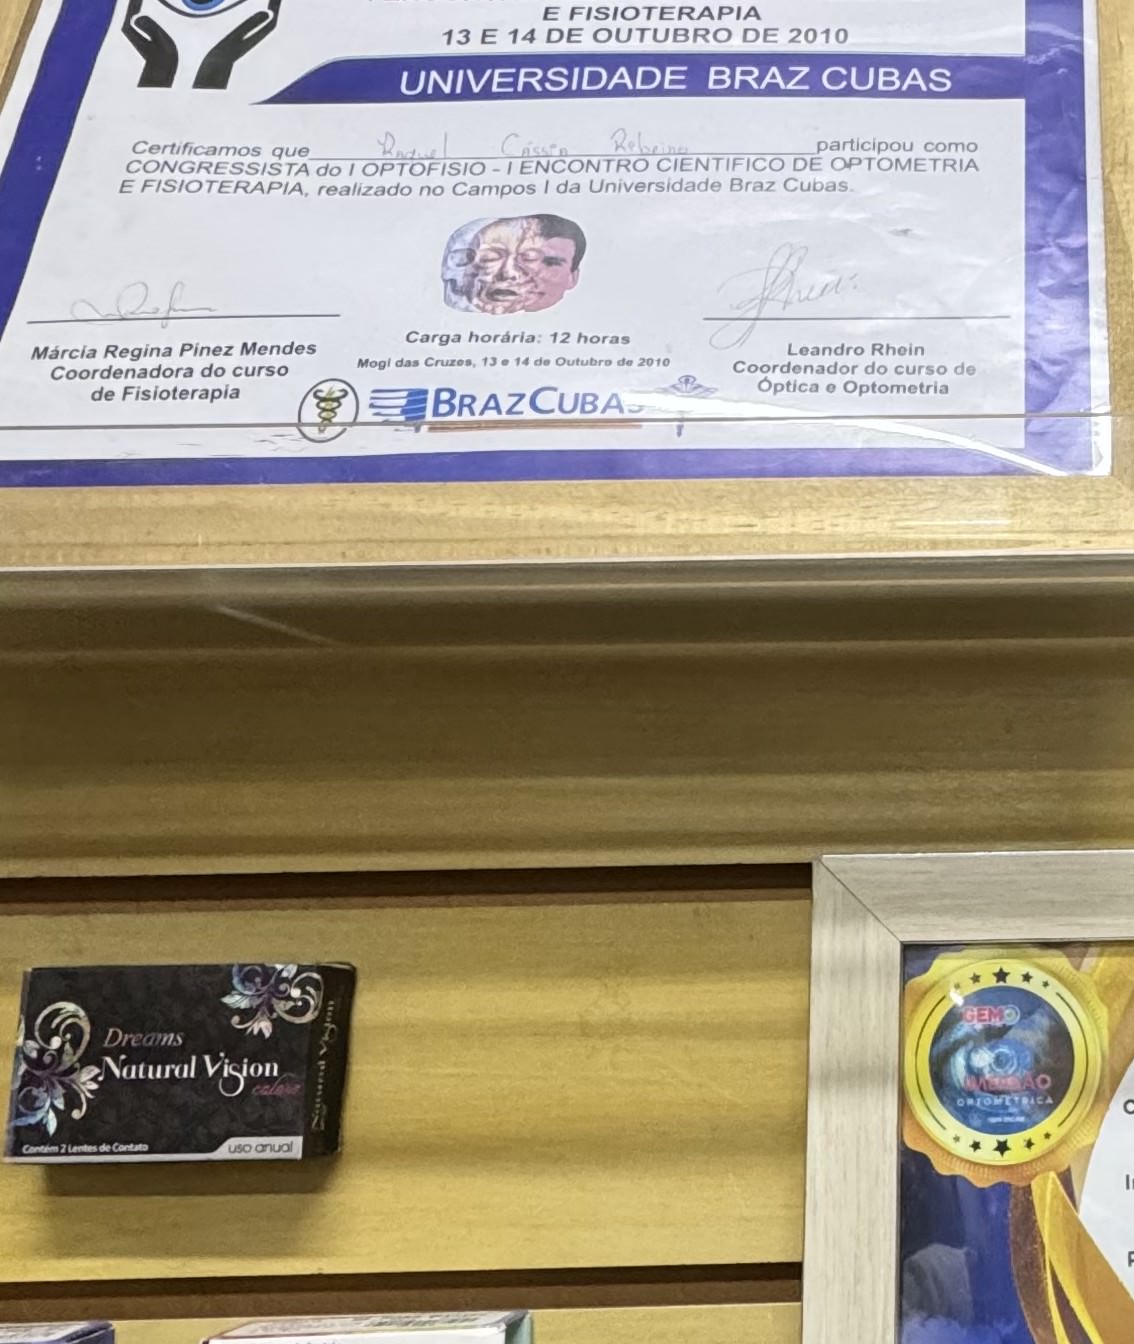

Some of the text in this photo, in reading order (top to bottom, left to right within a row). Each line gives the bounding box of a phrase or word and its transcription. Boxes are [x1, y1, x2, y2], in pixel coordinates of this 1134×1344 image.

[542, 5, 762, 22] E FISIOTERAPIA
[442, 27, 849, 46] 13 E 14 DE OUTUBRO DE 2010
[400, 65, 952, 96] UNIVERSIDADE BRAZ CUBAS
[405, 330, 631, 347] Carga horária: 12 horas
[30, 340, 317, 362] Márcia Regina Pinez Mendes
[787, 342, 925, 357] Leandro Rhein
[90, 383, 241, 404] de Fisioterapia
[103, 1028, 184, 1049] Dreams
[98, 1051, 279, 1097] Natural Vision
[228, 1139, 294, 1155] uso anual
